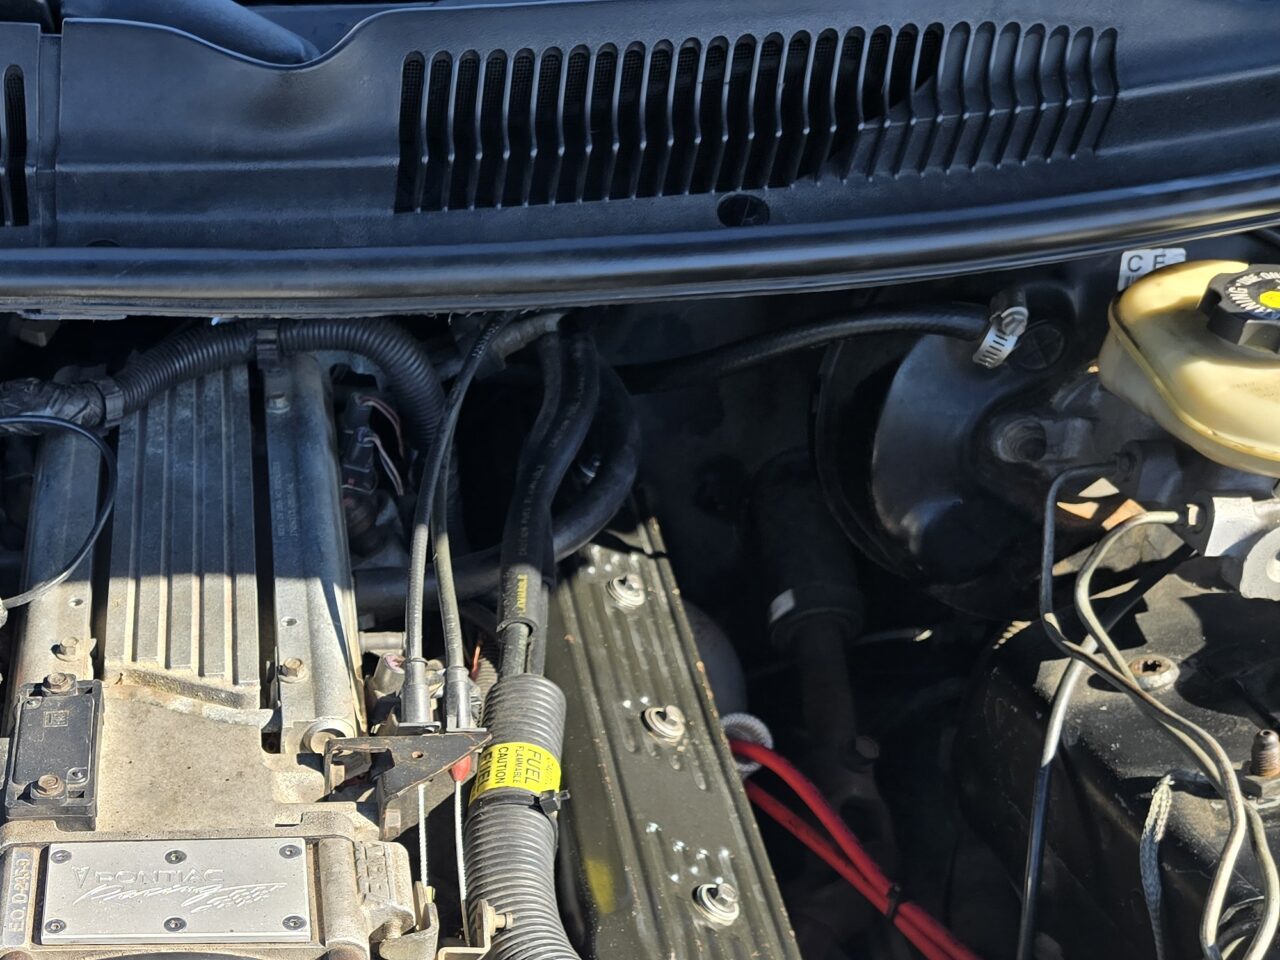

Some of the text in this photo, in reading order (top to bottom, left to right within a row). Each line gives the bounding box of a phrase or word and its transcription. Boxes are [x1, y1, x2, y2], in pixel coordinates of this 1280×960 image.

[495, 746, 509, 784] CAUTION
[525, 749, 542, 784] FUEL
[95, 869, 224, 884] PONTIAC
